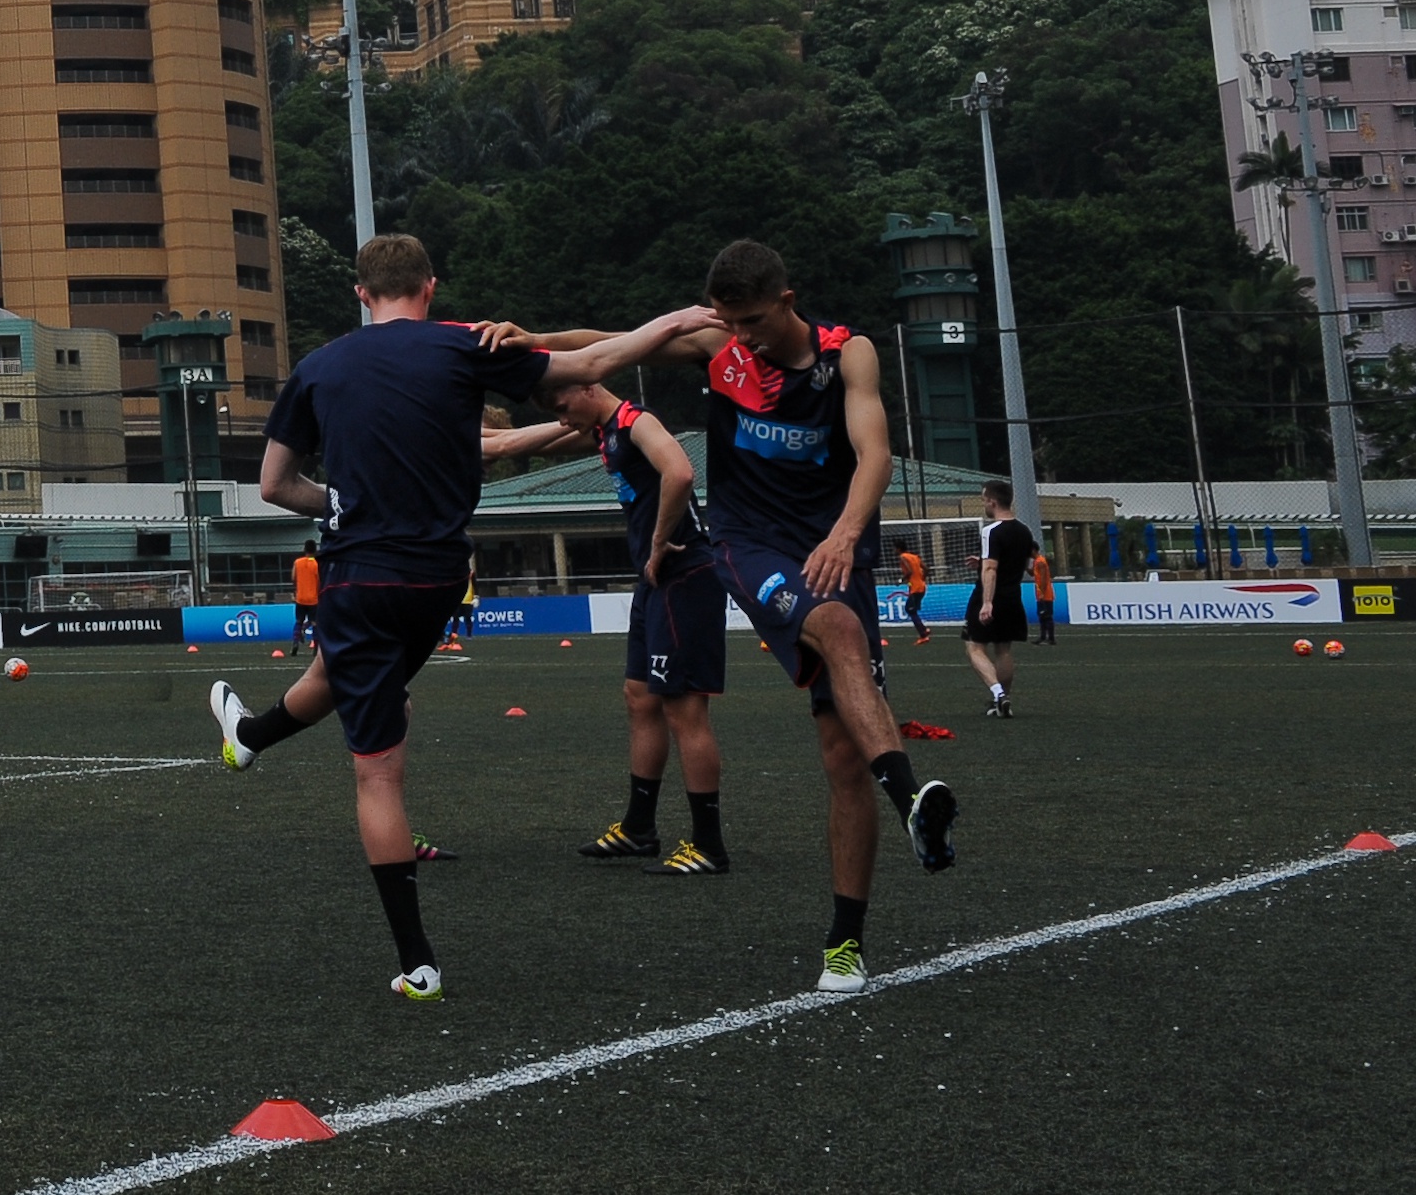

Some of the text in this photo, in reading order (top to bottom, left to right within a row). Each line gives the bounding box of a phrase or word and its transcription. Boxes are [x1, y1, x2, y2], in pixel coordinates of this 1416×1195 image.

[949, 325, 959, 339] 3
[183, 367, 209, 382] 3A
[723, 365, 746, 389] 51
[477, 610, 524, 623] POWER
[1086, 602, 1275, 621] BRITISH AIRWAYS
[57, 619, 163, 633] NIKE.COM/FOOTBALL
[224, 615, 259, 637] citi
[651, 655, 668, 668] 77
